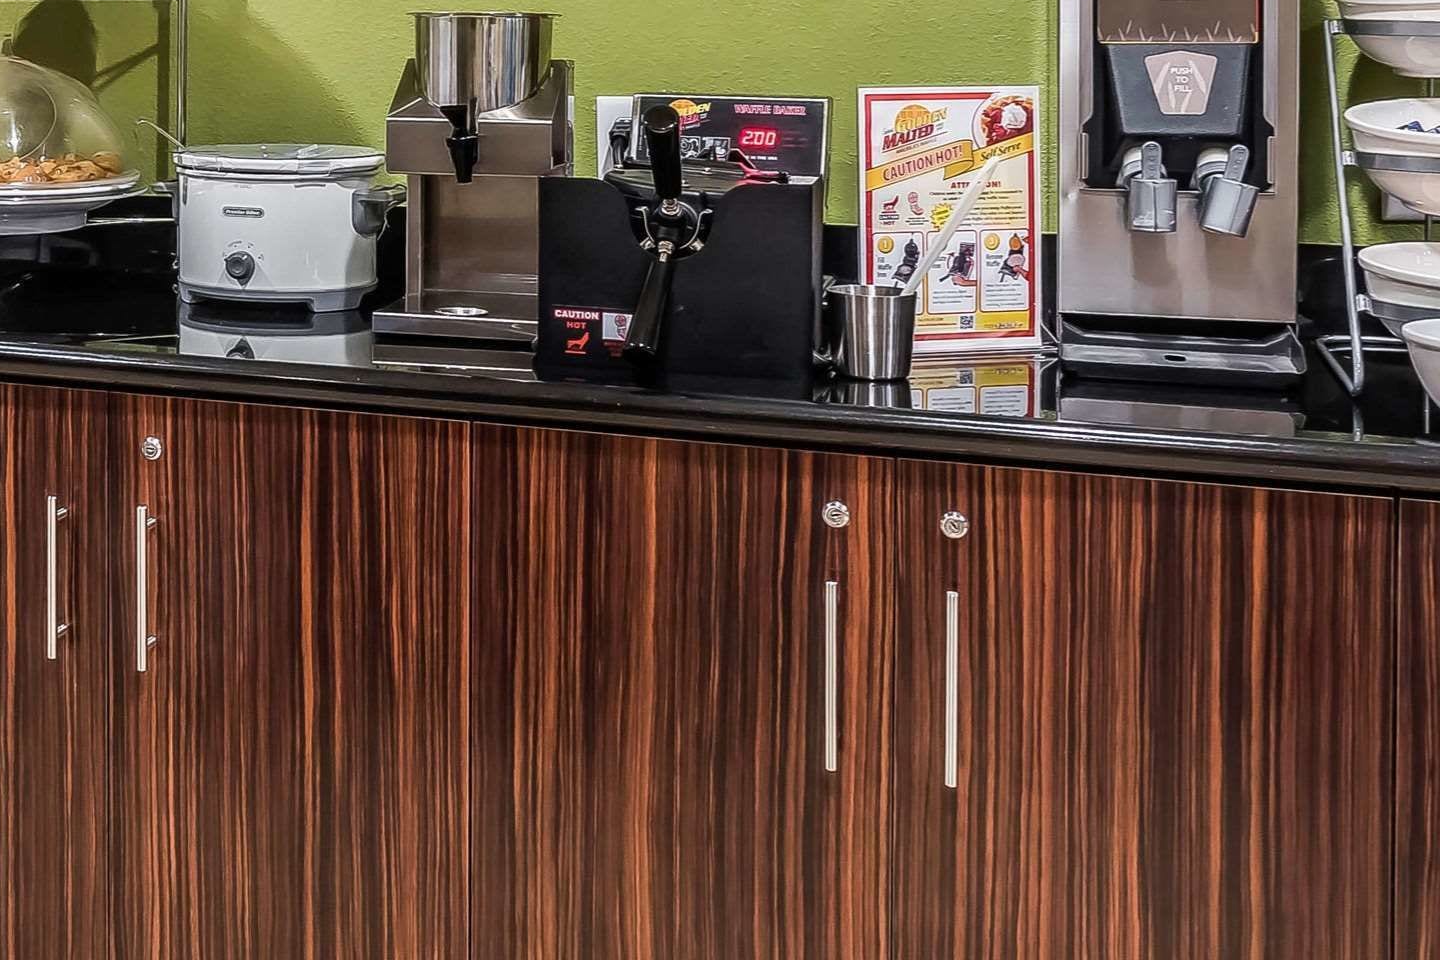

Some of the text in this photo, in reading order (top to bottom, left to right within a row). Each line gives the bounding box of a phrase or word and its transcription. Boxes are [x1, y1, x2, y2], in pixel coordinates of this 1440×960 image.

[1170, 67, 1193, 75] PUSH
[1175, 76, 1189, 84] TO
[1174, 84, 1193, 93] FILL
[679, 102, 711, 116] LDEN
[734, 103, 807, 116] WAFFLE BAKER
[882, 124, 935, 150] MALTED
[979, 142, 1022, 162] Self Serve
[882, 144, 963, 181] CAUTION HOT!
[554, 309, 600, 320] CAUTION
[566, 321, 587, 329] HOT
